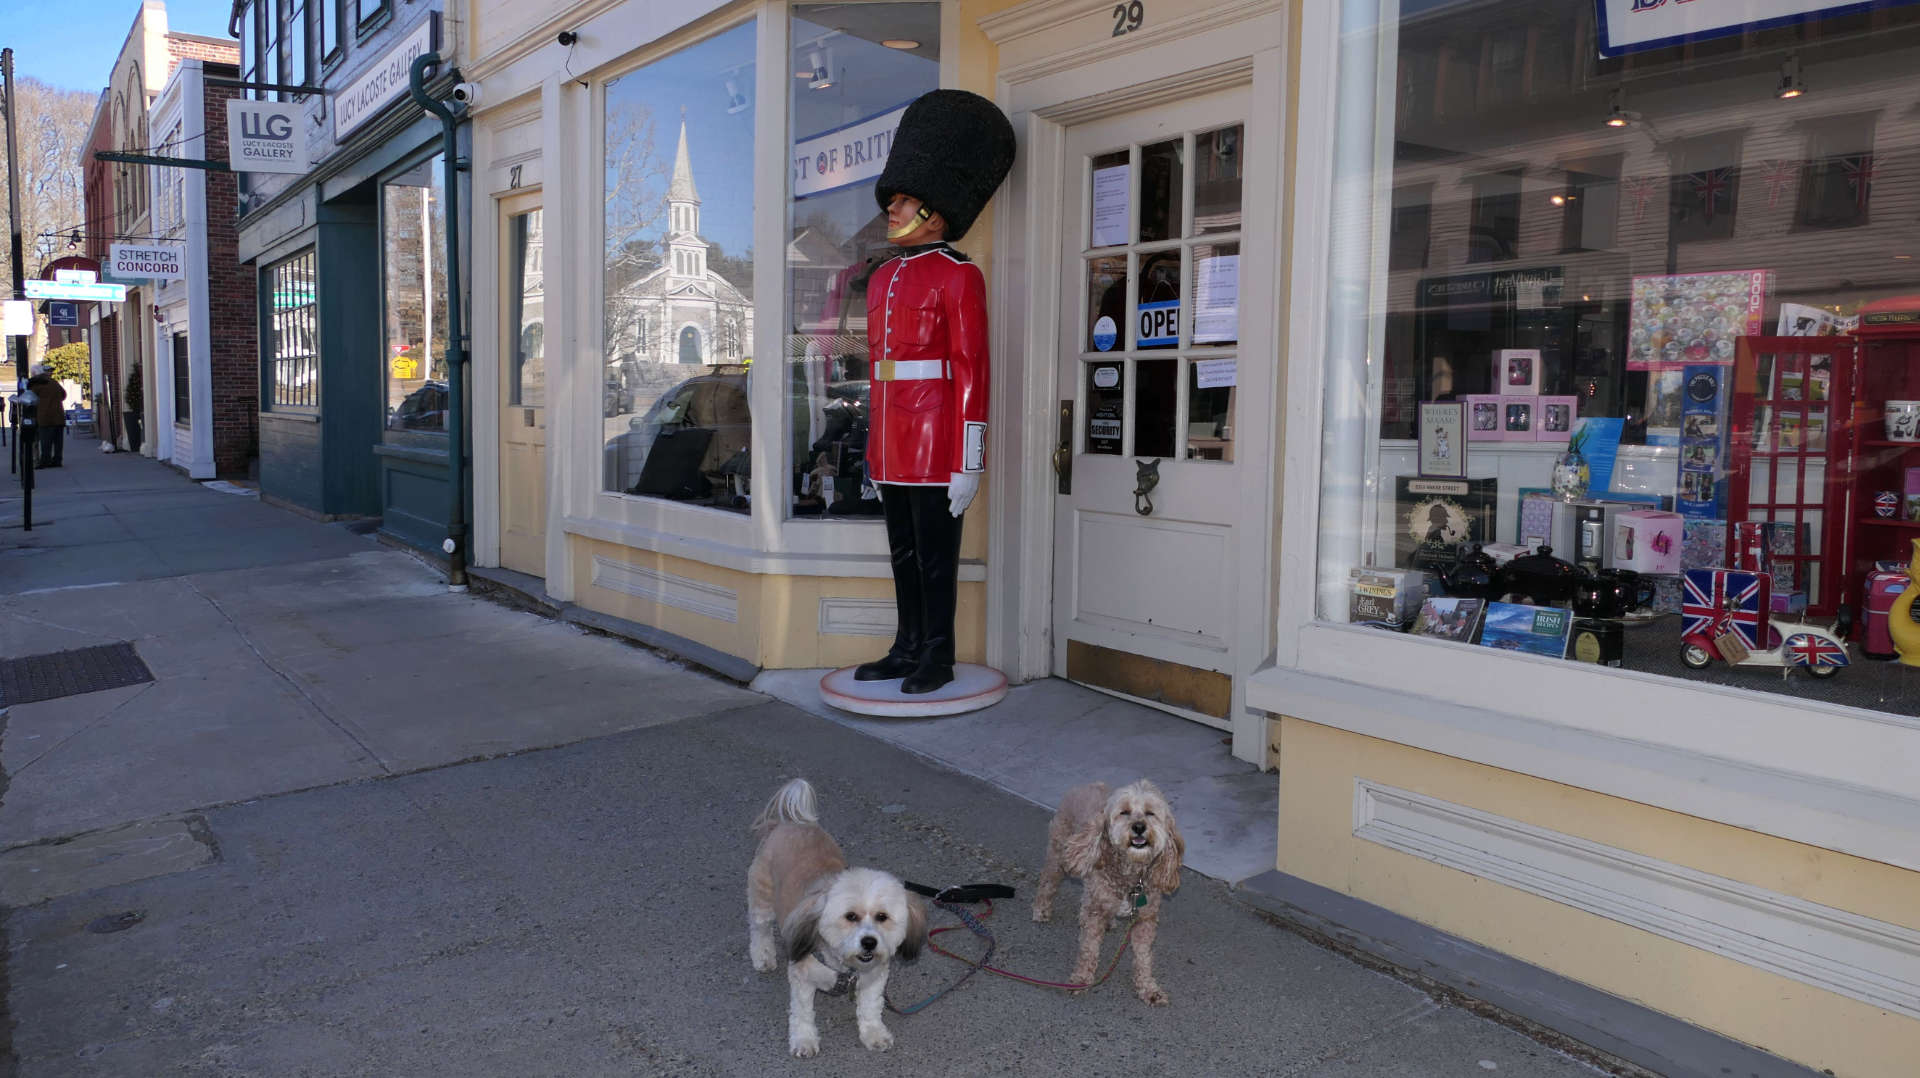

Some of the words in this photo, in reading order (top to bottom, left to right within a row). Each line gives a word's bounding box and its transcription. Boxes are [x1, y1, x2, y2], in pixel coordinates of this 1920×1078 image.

[1112, 0, 1143, 37] 29
[339, 95, 356, 125] LUCY
[357, 70, 387, 112] LACOSTE
[389, 39, 422, 86] GALLERY
[241, 111, 293, 141] LLG
[242, 140, 260, 148] LUCY
[243, 147, 294, 159] GALLERY
[816, 148, 837, 175] OF
[510, 164, 522, 190] 27
[119, 249, 177, 262] STRETCH
[117, 261, 179, 273] CONCORD
[1750, 272, 1761, 313] 1000
[1091, 423, 1120, 437] SECURITY
[1359, 584, 1392, 595] TWININGS
[1358, 603, 1379, 614] GREY
[1537, 615, 1561, 625] IRISH
